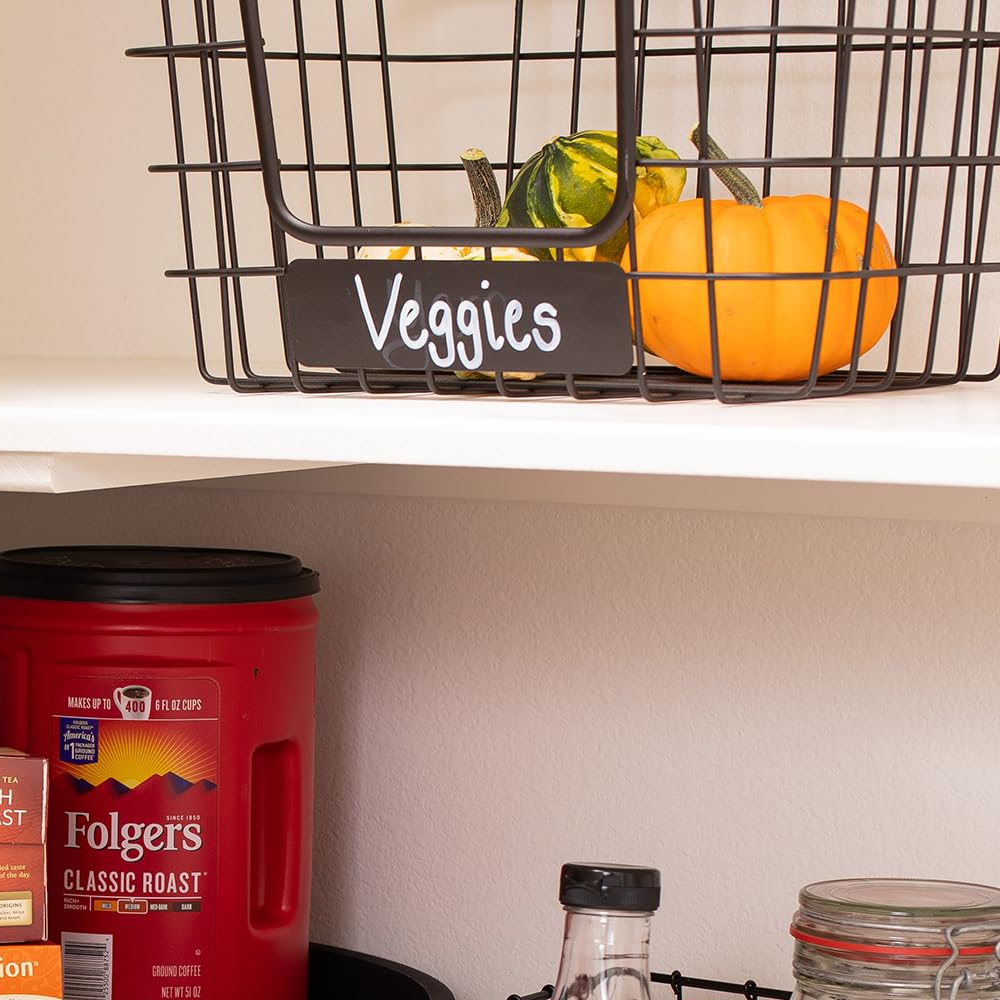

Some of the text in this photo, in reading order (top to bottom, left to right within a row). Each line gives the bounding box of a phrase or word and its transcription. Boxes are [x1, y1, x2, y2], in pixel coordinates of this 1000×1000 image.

[354, 272, 561, 370] Veggies
[67, 696, 202, 713] MAKES UP TO 400 6 FL OZ CUPS
[2, 776, 19, 784] TEA
[64, 812, 202, 862] Folgers
[64, 868, 202, 894] CLASSIC ROAST
[152, 964, 202, 977] GROUND COFFEE
[162, 986, 201, 998] NET WT 51 OZ
